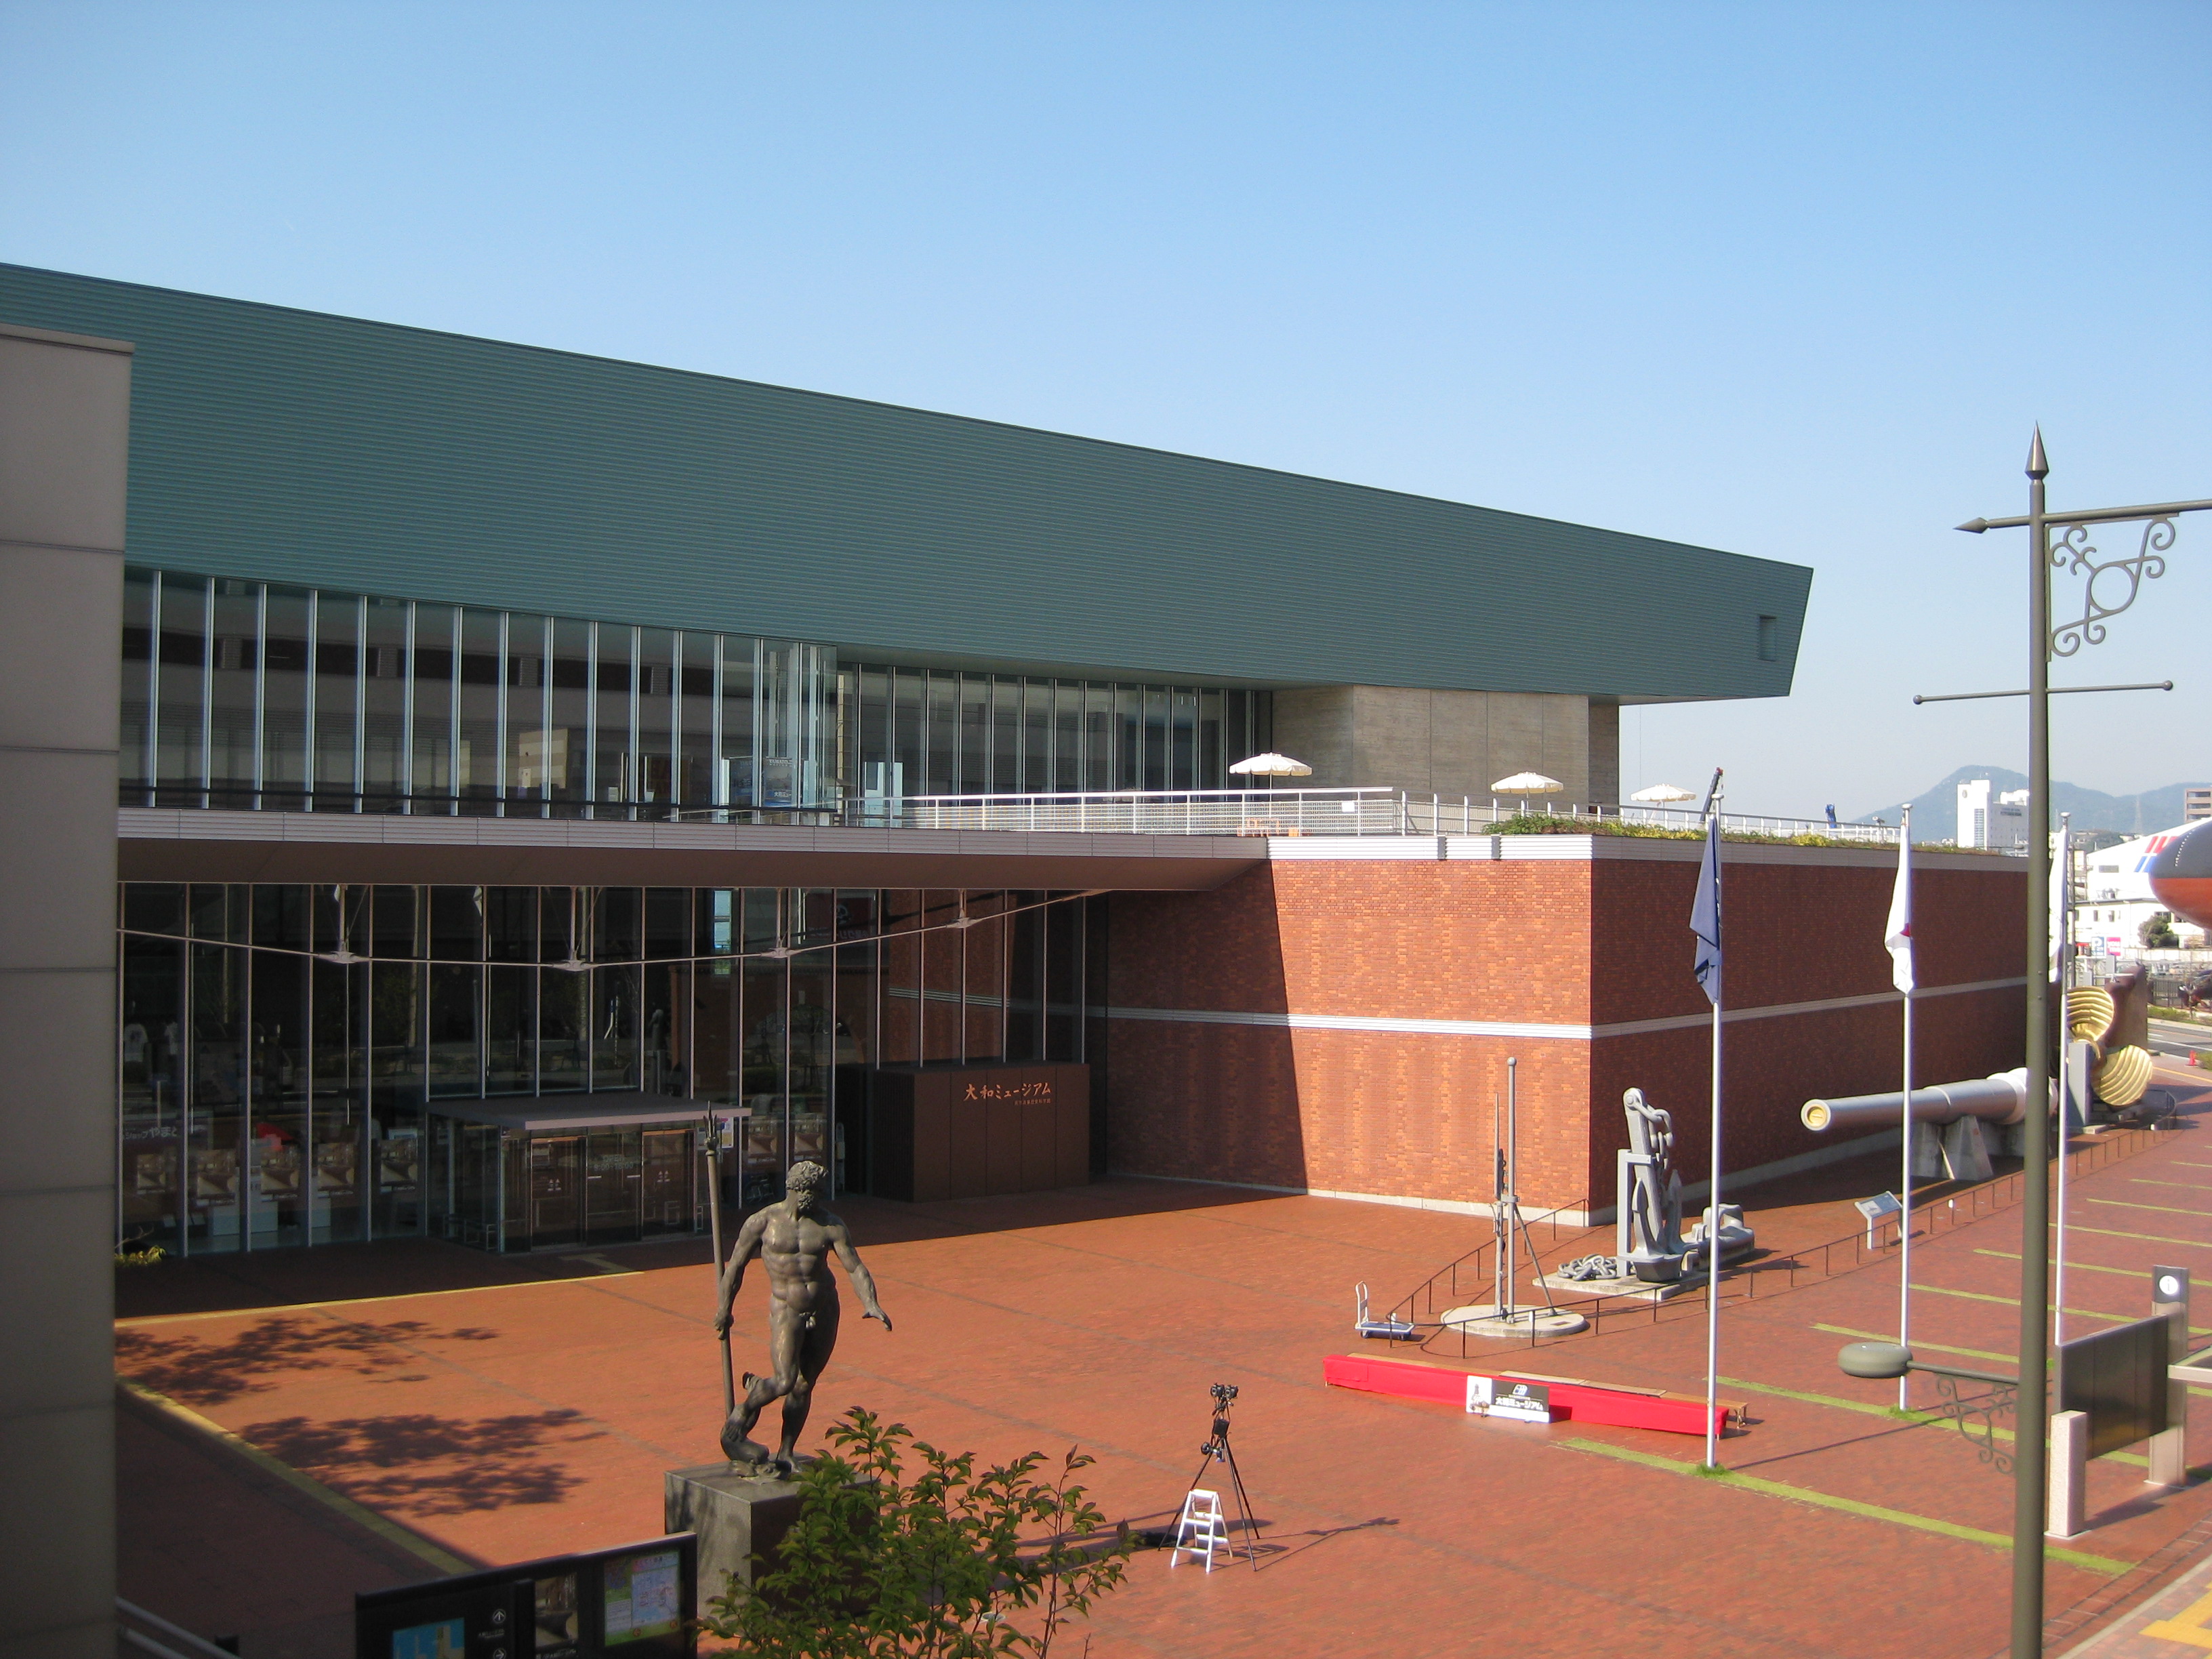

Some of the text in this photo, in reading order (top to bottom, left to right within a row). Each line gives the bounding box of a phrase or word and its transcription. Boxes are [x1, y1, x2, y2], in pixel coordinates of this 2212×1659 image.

[963, 1082, 1052, 1101] 大和ミュージアム
[1496, 1396, 1544, 1411] 大和ミュージアム
